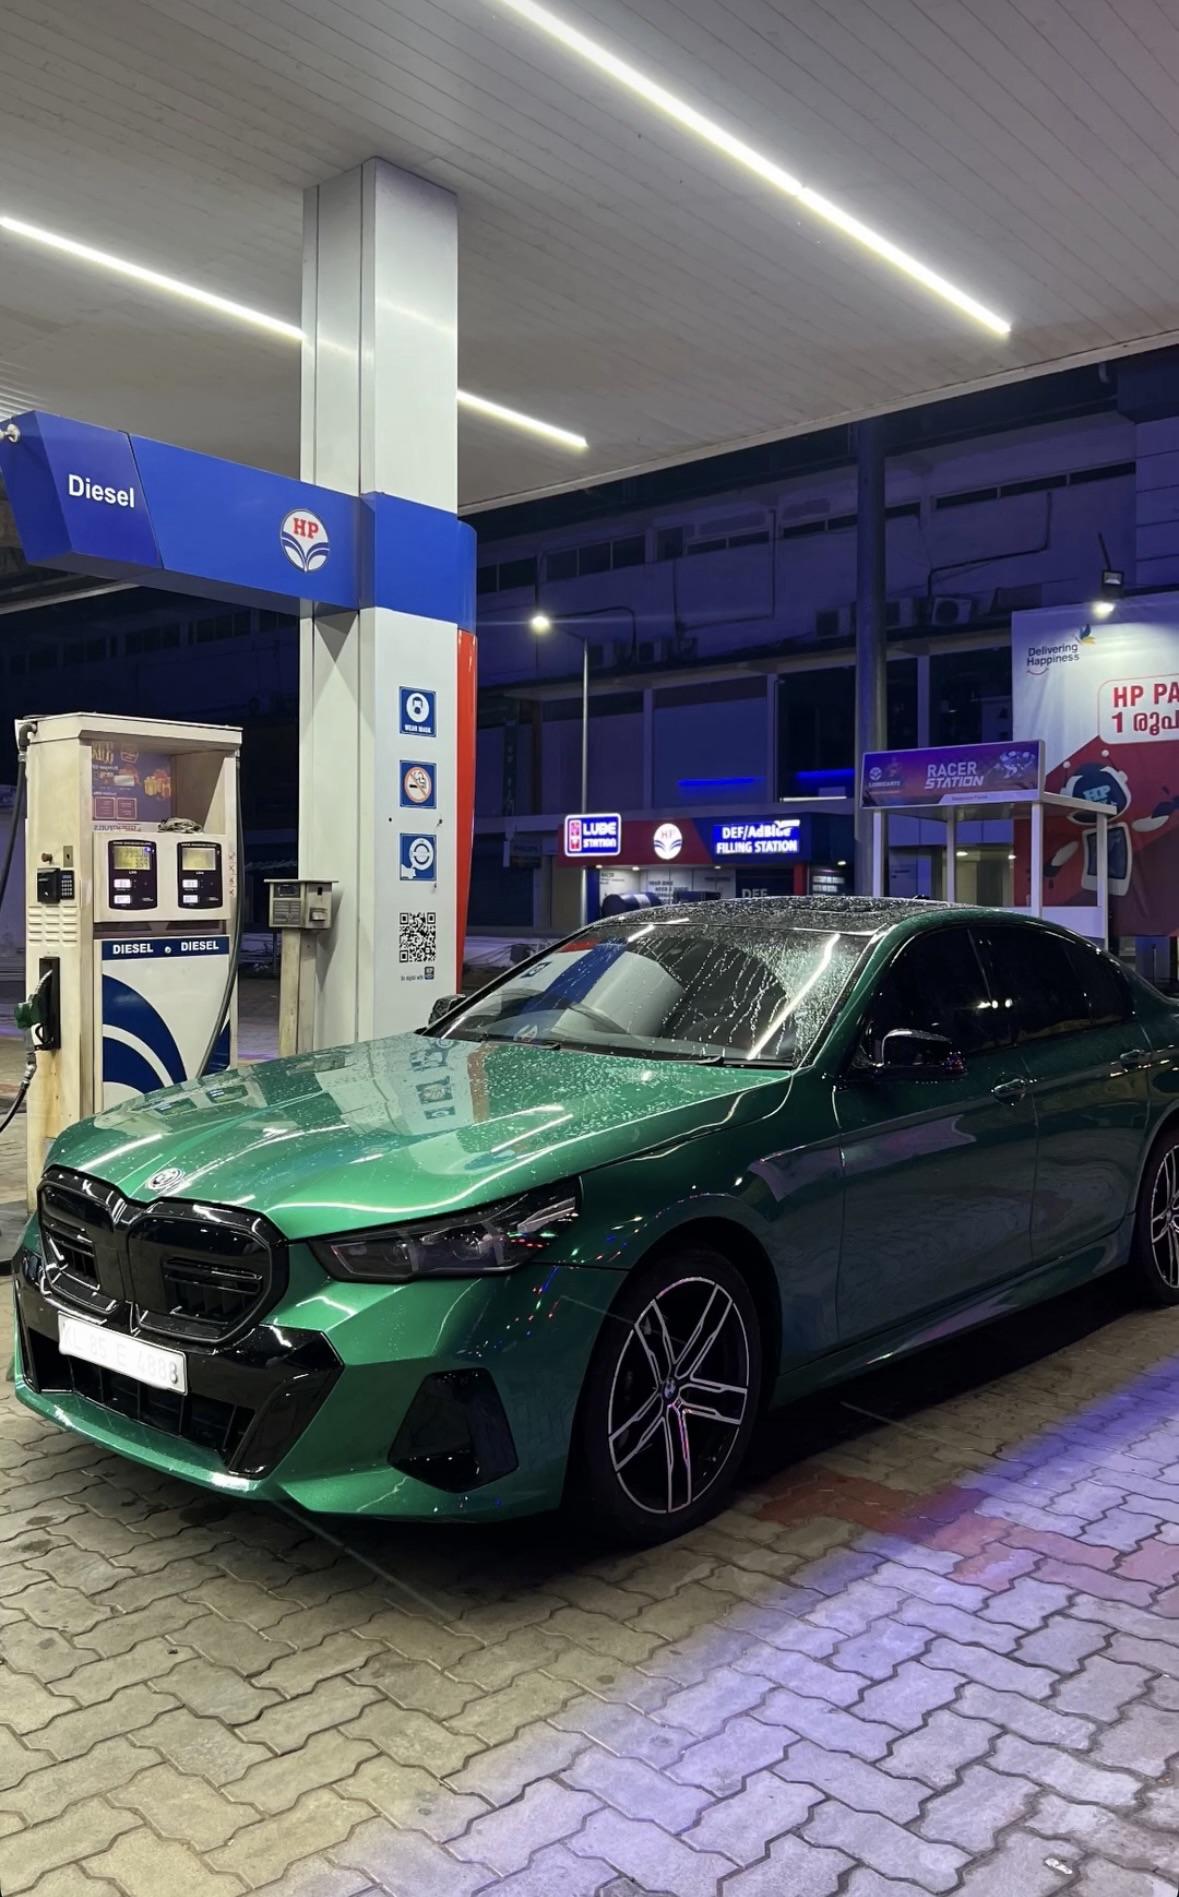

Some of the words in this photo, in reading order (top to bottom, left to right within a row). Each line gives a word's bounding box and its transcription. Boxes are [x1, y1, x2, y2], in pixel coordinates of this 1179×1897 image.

[68, 474, 135, 508] Diesel
[293, 517, 319, 539] HP
[1028, 643, 1078, 657] Delivering
[1026, 653, 1080, 667] Happiness
[1113, 686, 1144, 708] HP
[1111, 711, 1123, 733] 1
[927, 762, 977, 778] RACER
[924, 775, 984, 790] STATION
[583, 821, 617, 836] LUBE
[716, 841, 753, 854] FILLING
[754, 839, 798, 853] STATION
[112, 943, 154, 955] DIESEL
[181, 940, 219, 952] DIESEL
